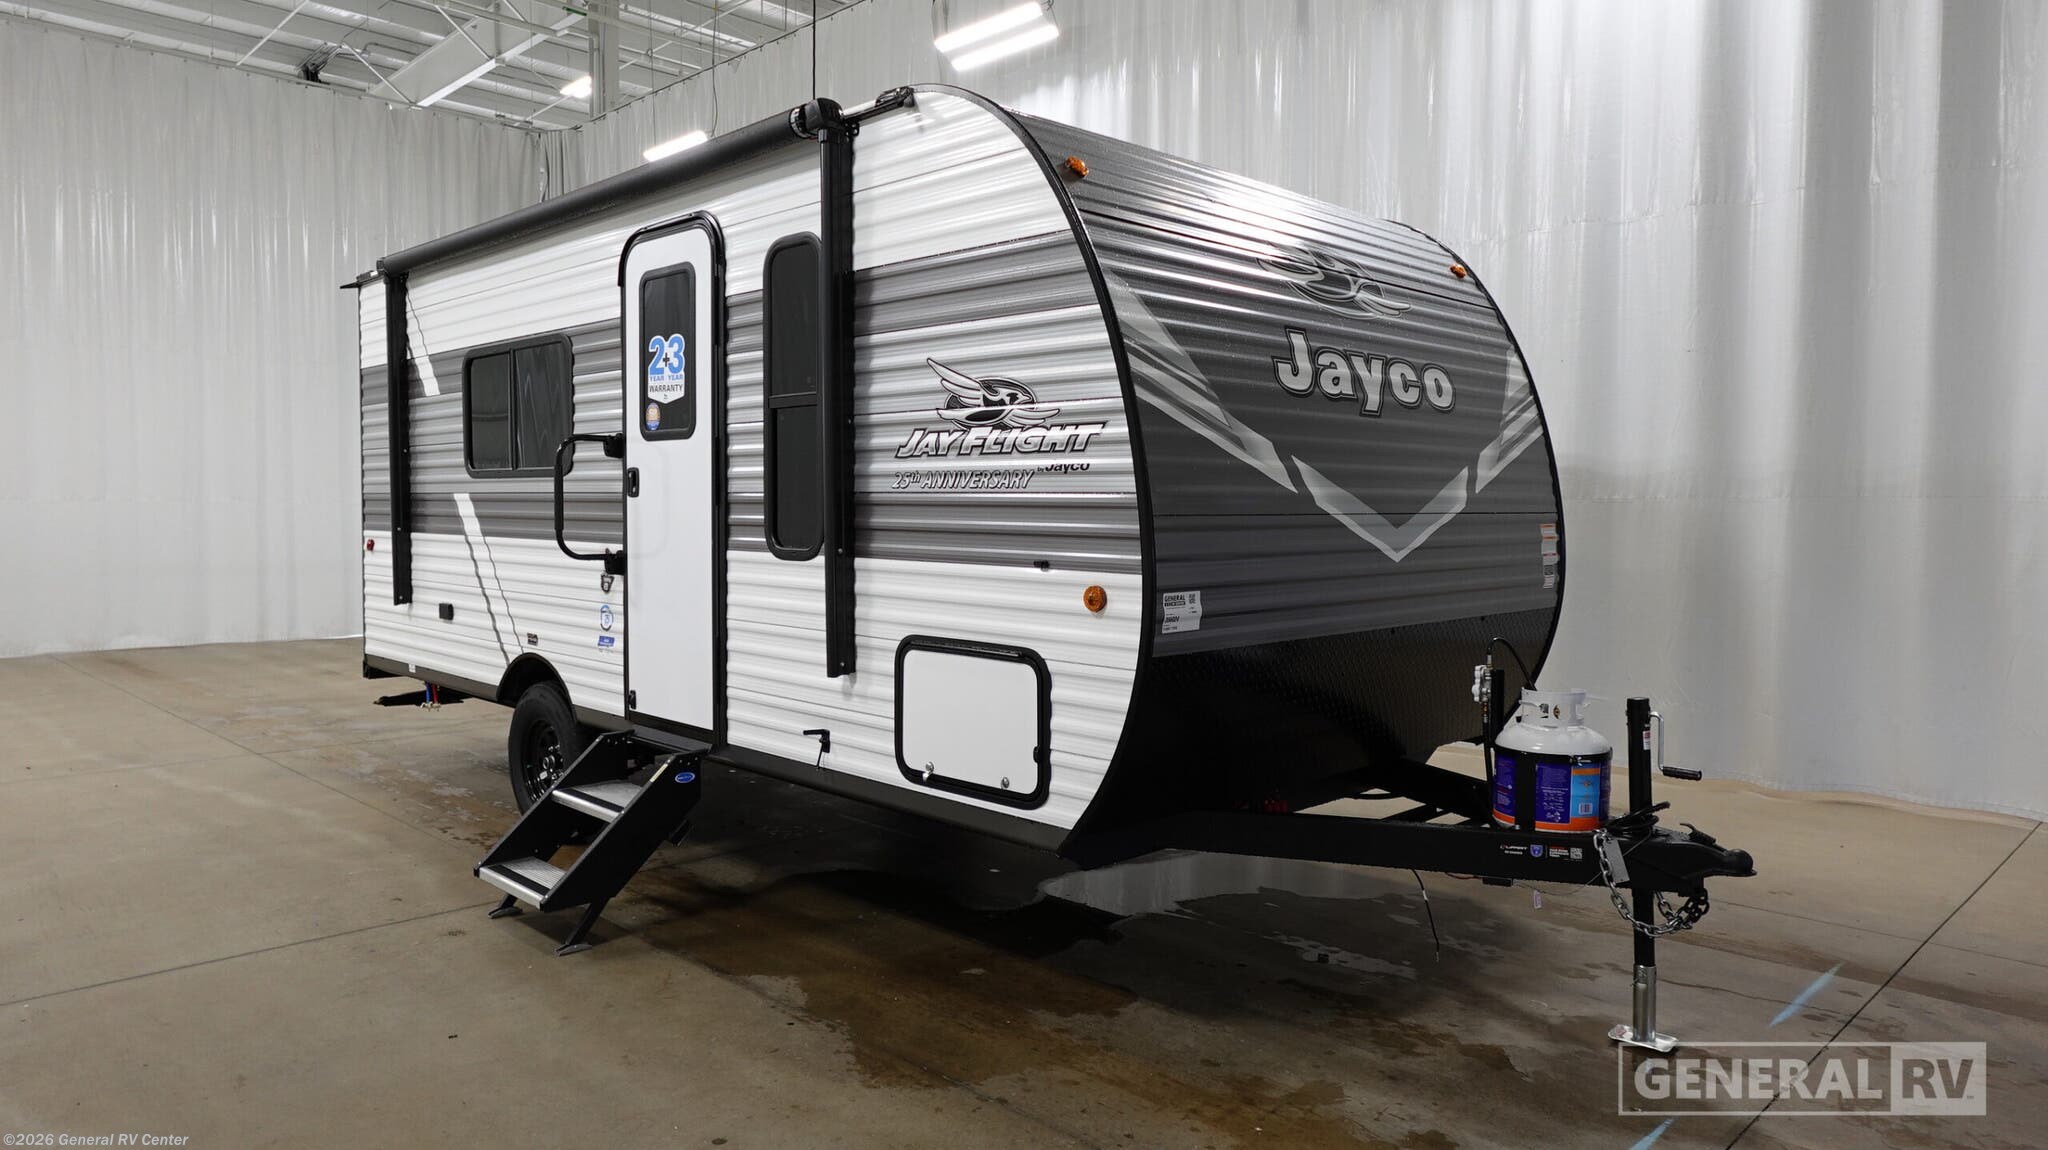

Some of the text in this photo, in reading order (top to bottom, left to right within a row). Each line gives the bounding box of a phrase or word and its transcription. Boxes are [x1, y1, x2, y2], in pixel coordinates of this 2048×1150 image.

[1273, 327, 1455, 416] Jayco
[649, 384, 683, 393] WARRANTY
[895, 422, 1107, 458] JAY FLIGHT
[1045, 462, 1090, 474] Jayco
[892, 469, 1035, 489] 25th ANNIVERSARY
